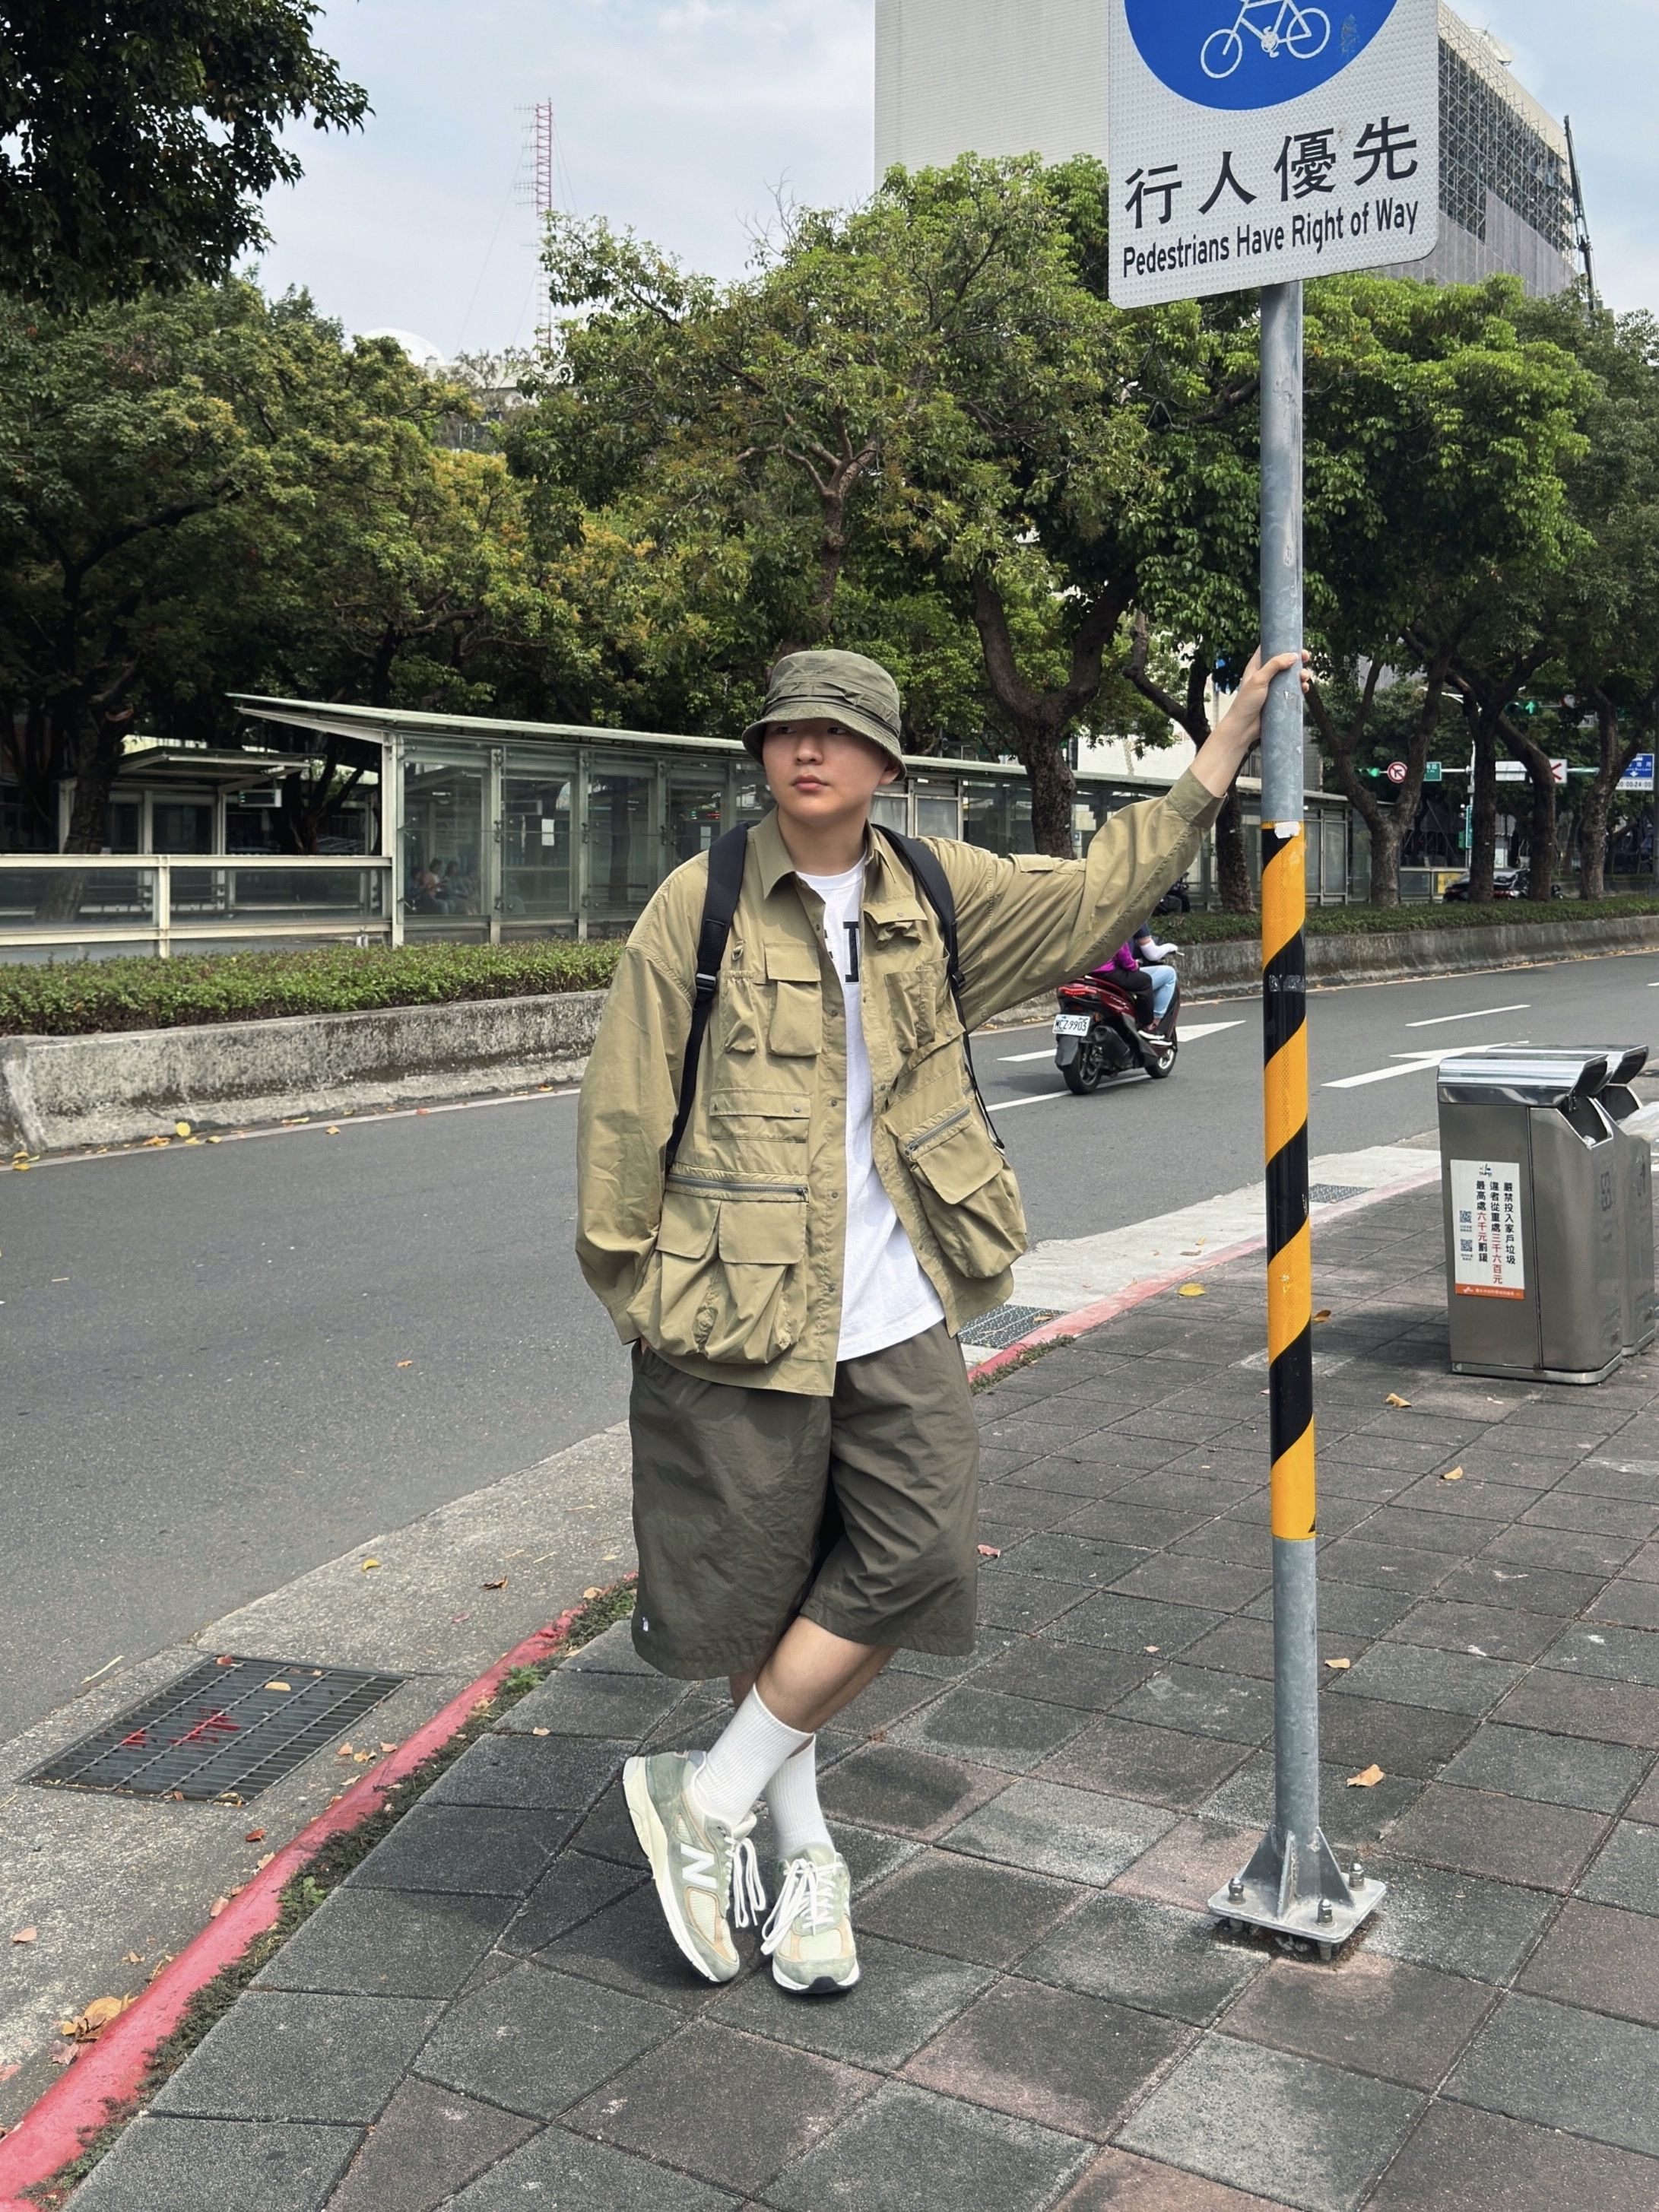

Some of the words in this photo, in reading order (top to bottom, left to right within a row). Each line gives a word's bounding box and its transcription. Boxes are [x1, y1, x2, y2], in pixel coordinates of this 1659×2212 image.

[1125, 116, 1419, 230] 行人優先
[1123, 235, 1229, 278] Pedestrians
[1237, 224, 1285, 258] Have
[1292, 206, 1344, 254] Right
[1350, 202, 1369, 236] of
[1375, 198, 1419, 235] Way
[1489, 1181, 1503, 1284] 違者從重處三千六百元
[1503, 1182, 1516, 1265] 嚴禁投入家戶垃圾
